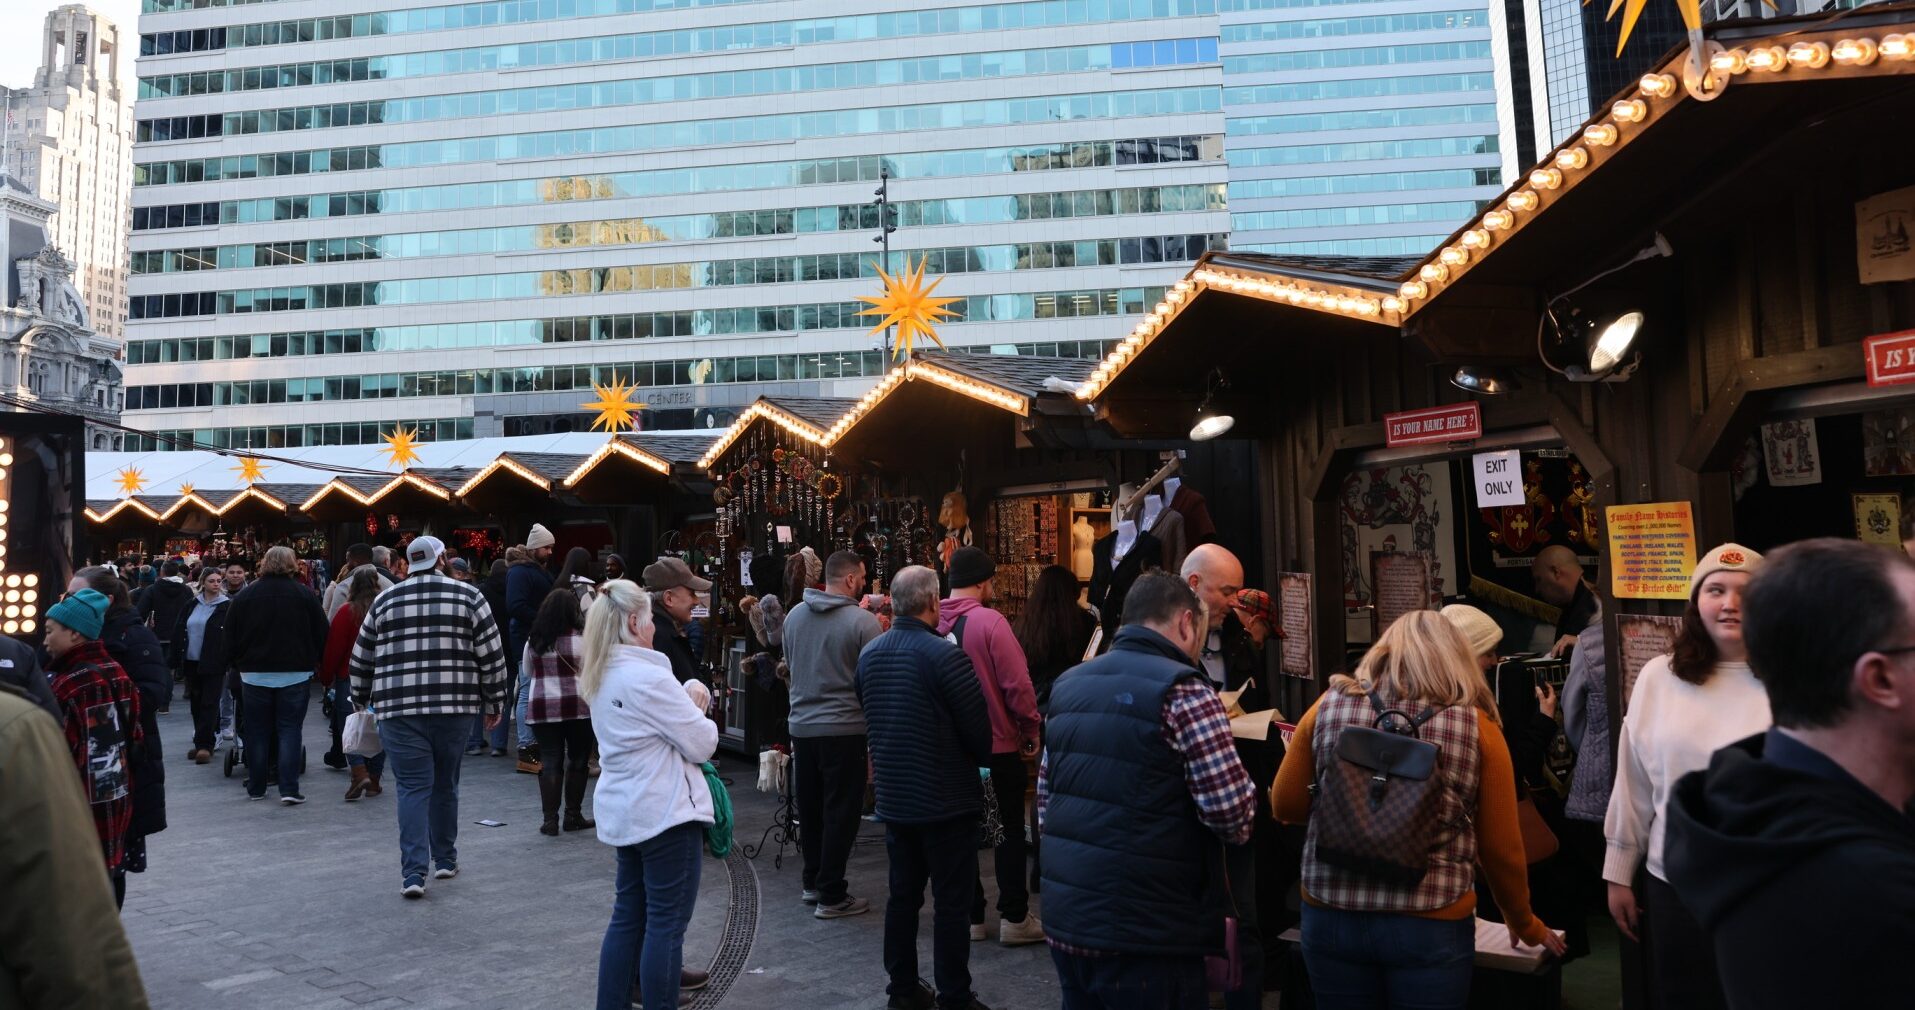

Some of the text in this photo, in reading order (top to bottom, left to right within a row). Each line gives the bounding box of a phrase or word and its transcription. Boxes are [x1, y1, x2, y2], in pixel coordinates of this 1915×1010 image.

[1884, 349, 1904, 369] IS
[647, 393, 692, 405] CENTER
[1393, 424, 1401, 436] IS
[1402, 421, 1421, 434] YOUR
[1423, 418, 1445, 432] NAME
[1446, 415, 1468, 430] HERE
[1485, 459, 1508, 474] EXIT
[1485, 480, 1513, 496] ONLY
[1610, 512, 1633, 523] Family
[1634, 511, 1655, 522] Name
[1507, 558, 1533, 566] PORTUGA
[1641, 583, 1665, 594] Perfect
